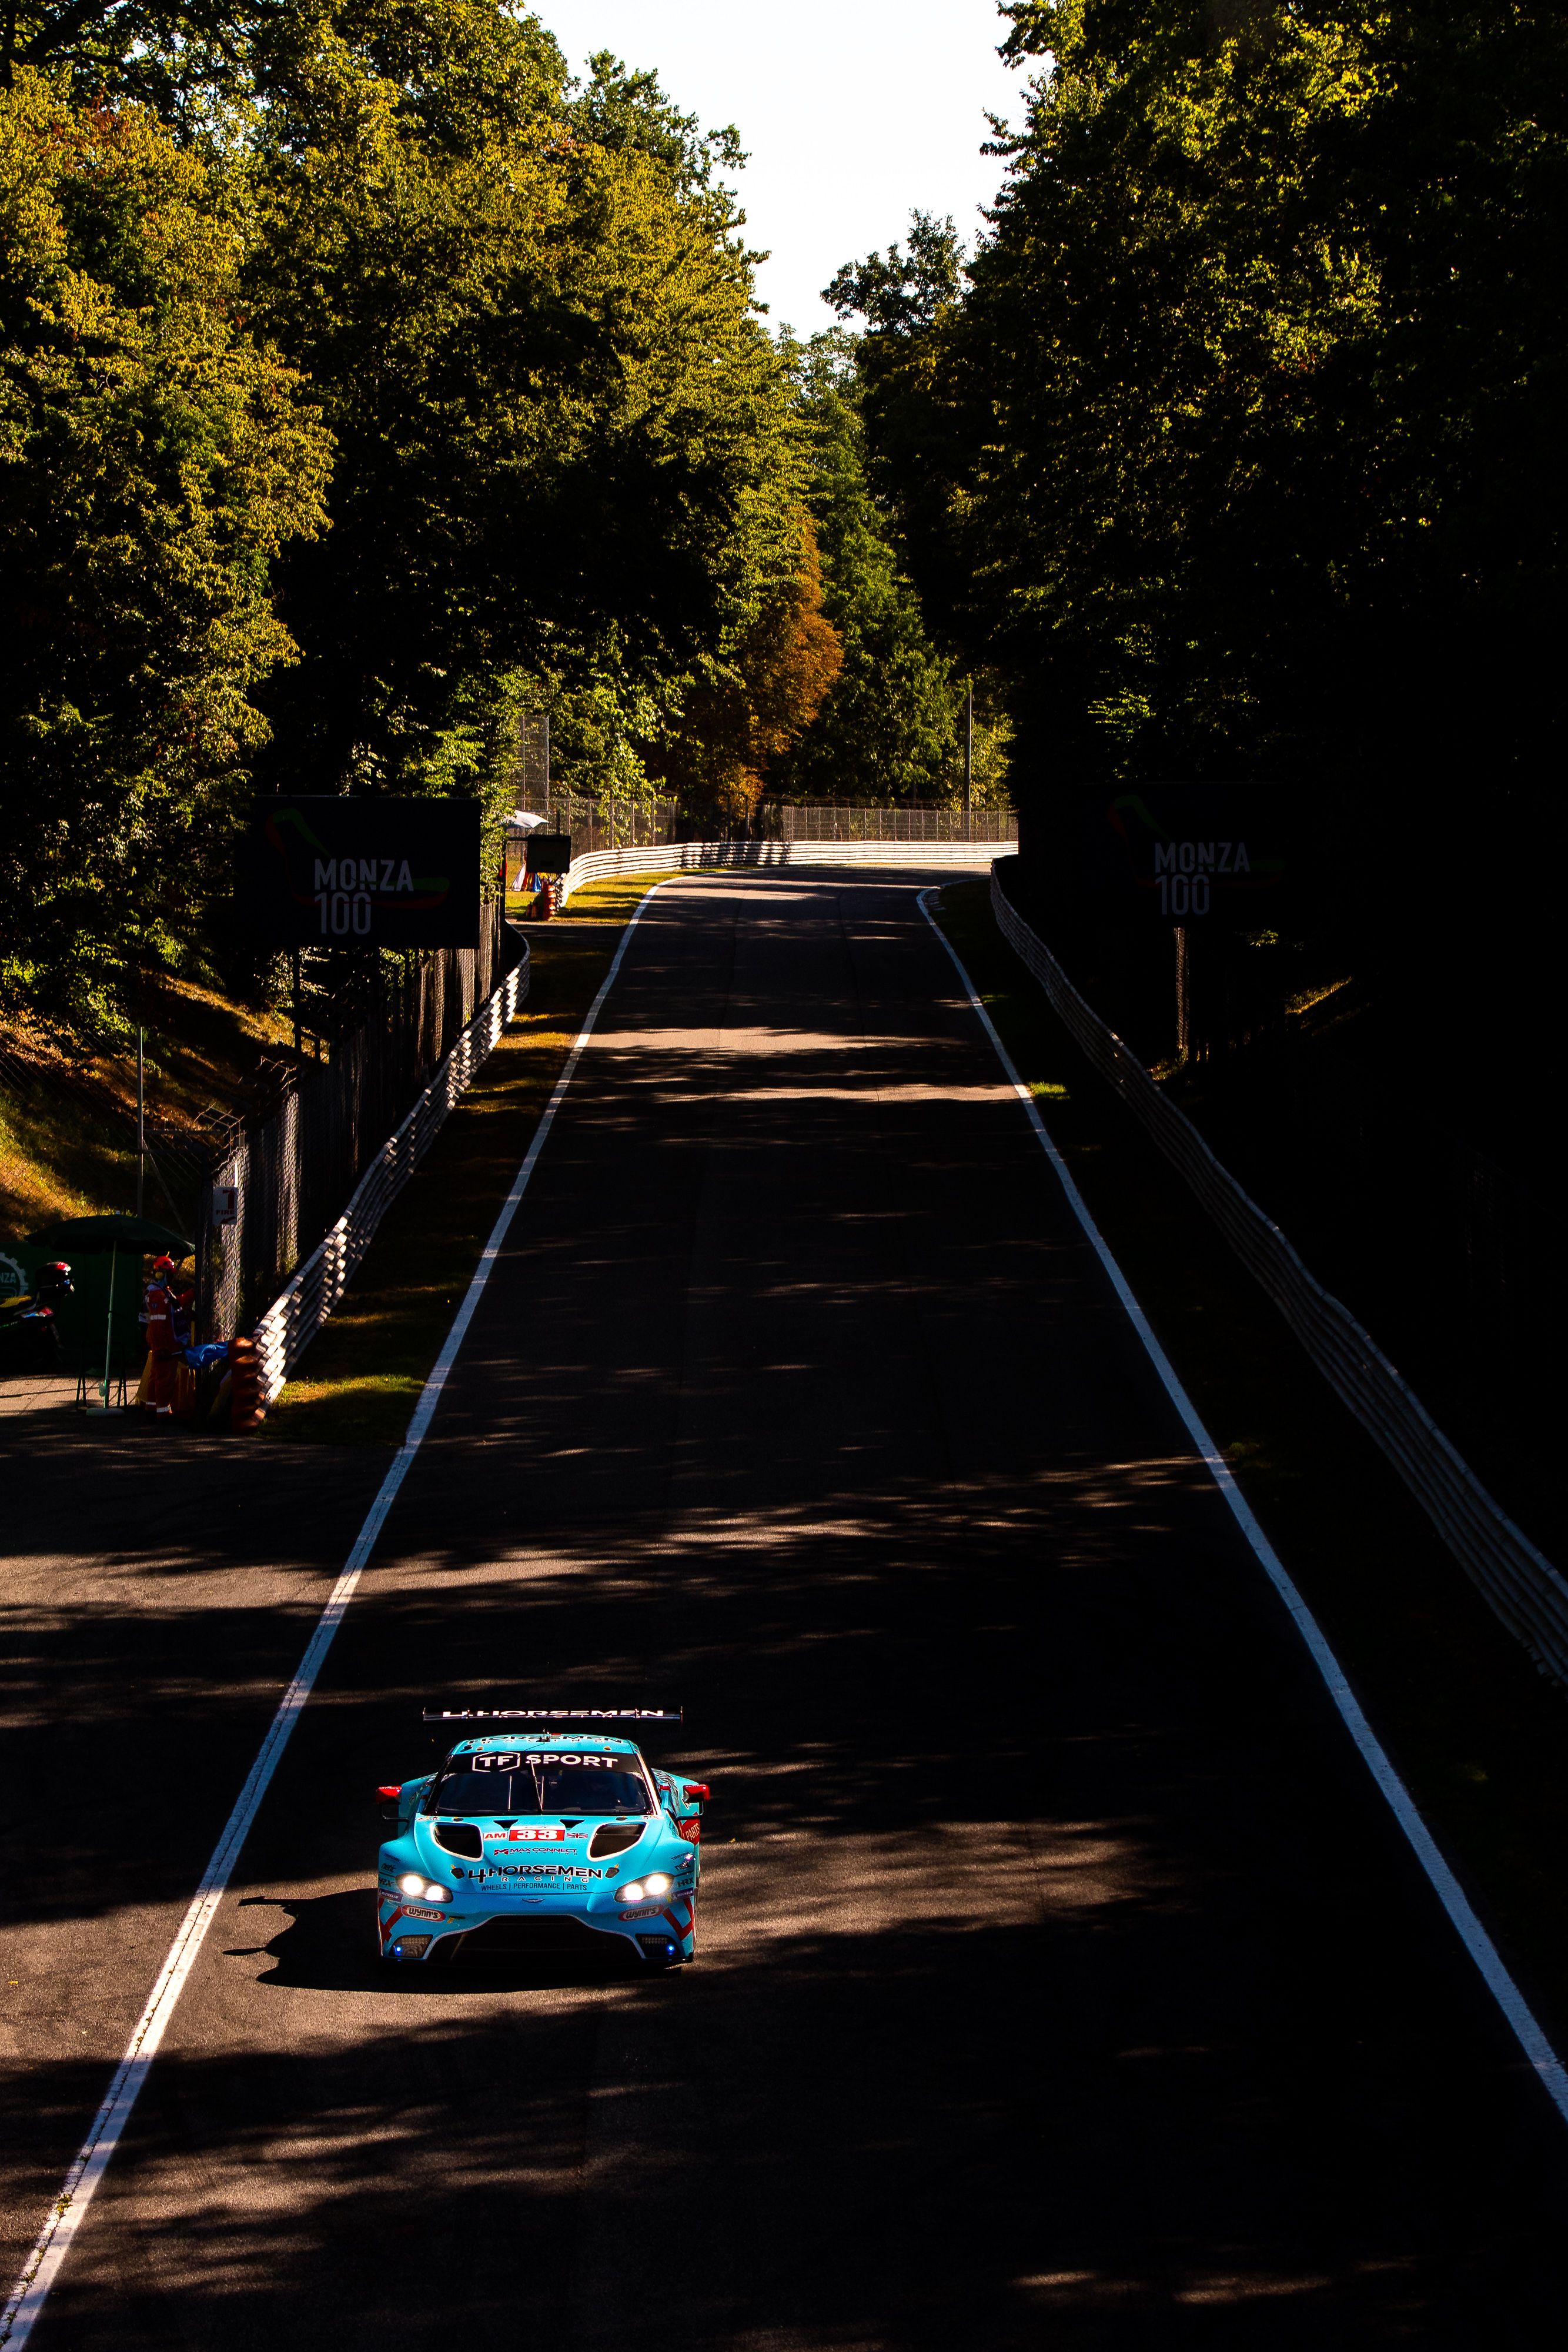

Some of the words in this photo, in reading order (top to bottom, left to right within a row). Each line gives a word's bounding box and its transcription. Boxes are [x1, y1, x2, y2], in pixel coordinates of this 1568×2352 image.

[1155, 841, 1251, 873] MONZA
[314, 858, 414, 892] MONZA
[1155, 874, 1210, 915] 100
[314, 891, 372, 935] 100
[479, 1755, 513, 1767] TF
[526, 1755, 618, 1768] SPORT
[516, 1829, 558, 1840] 33
[481, 1883, 507, 1892] WHEELS
